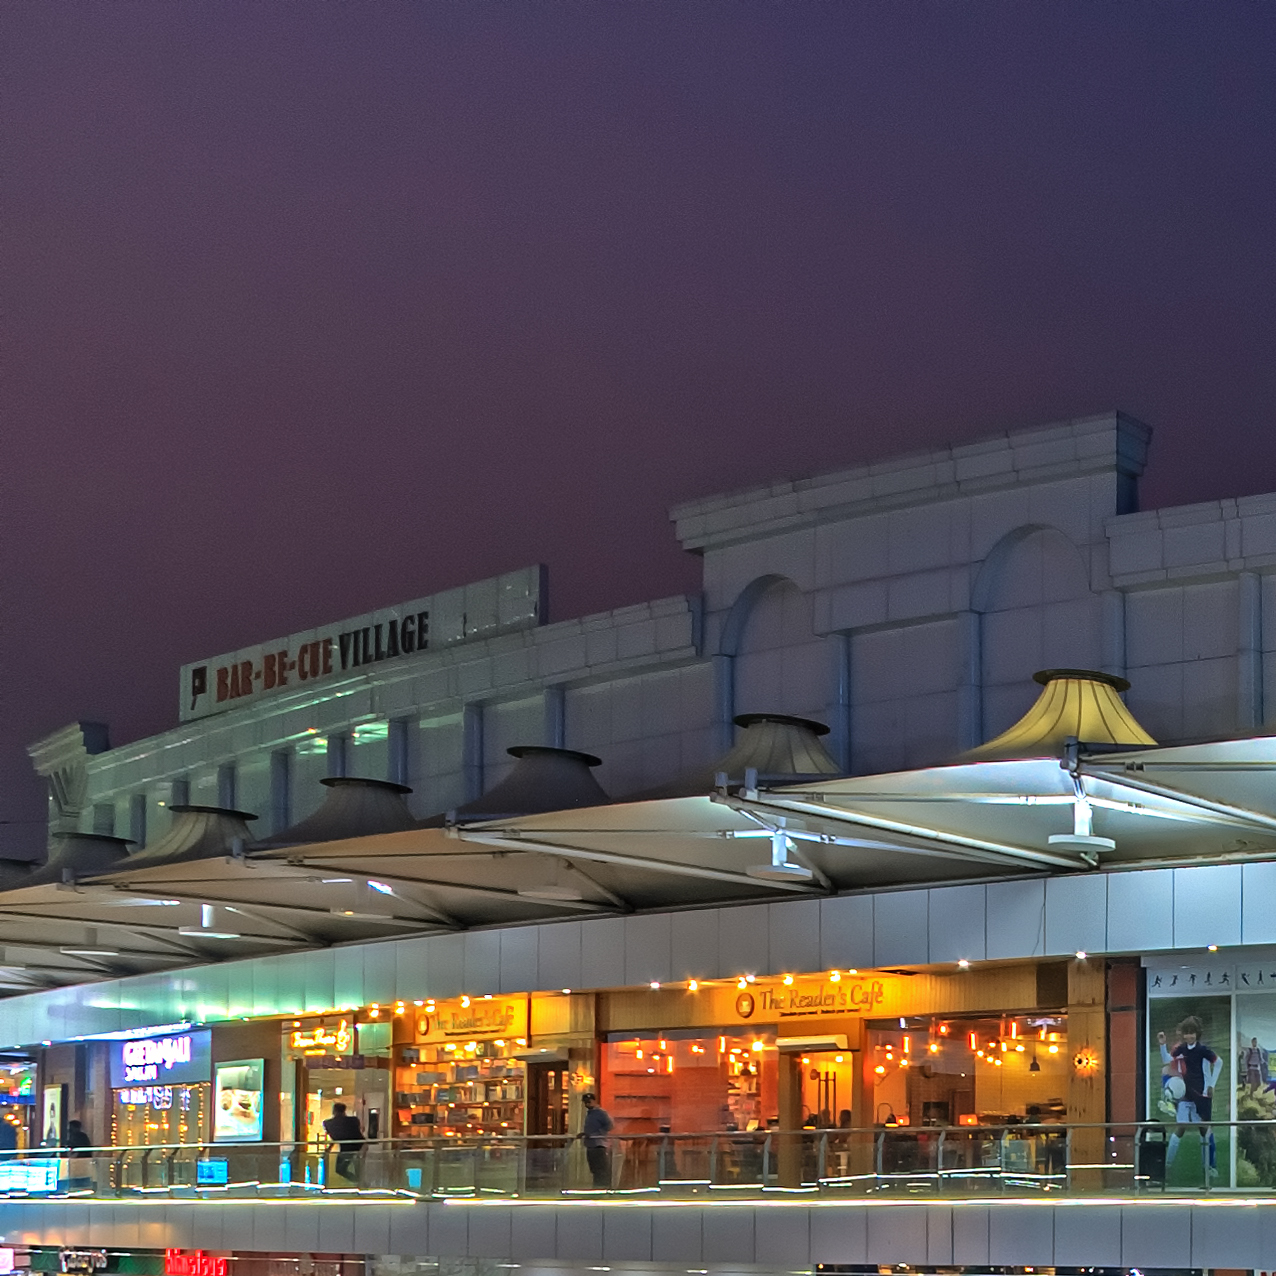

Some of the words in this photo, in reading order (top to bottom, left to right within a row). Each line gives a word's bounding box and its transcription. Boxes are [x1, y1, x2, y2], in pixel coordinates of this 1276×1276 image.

[215, 637, 334, 704] BAR-BE-CUE
[338, 610, 430, 671] VILLAGE
[759, 987, 785, 1011] The
[850, 980, 885, 1013] Café
